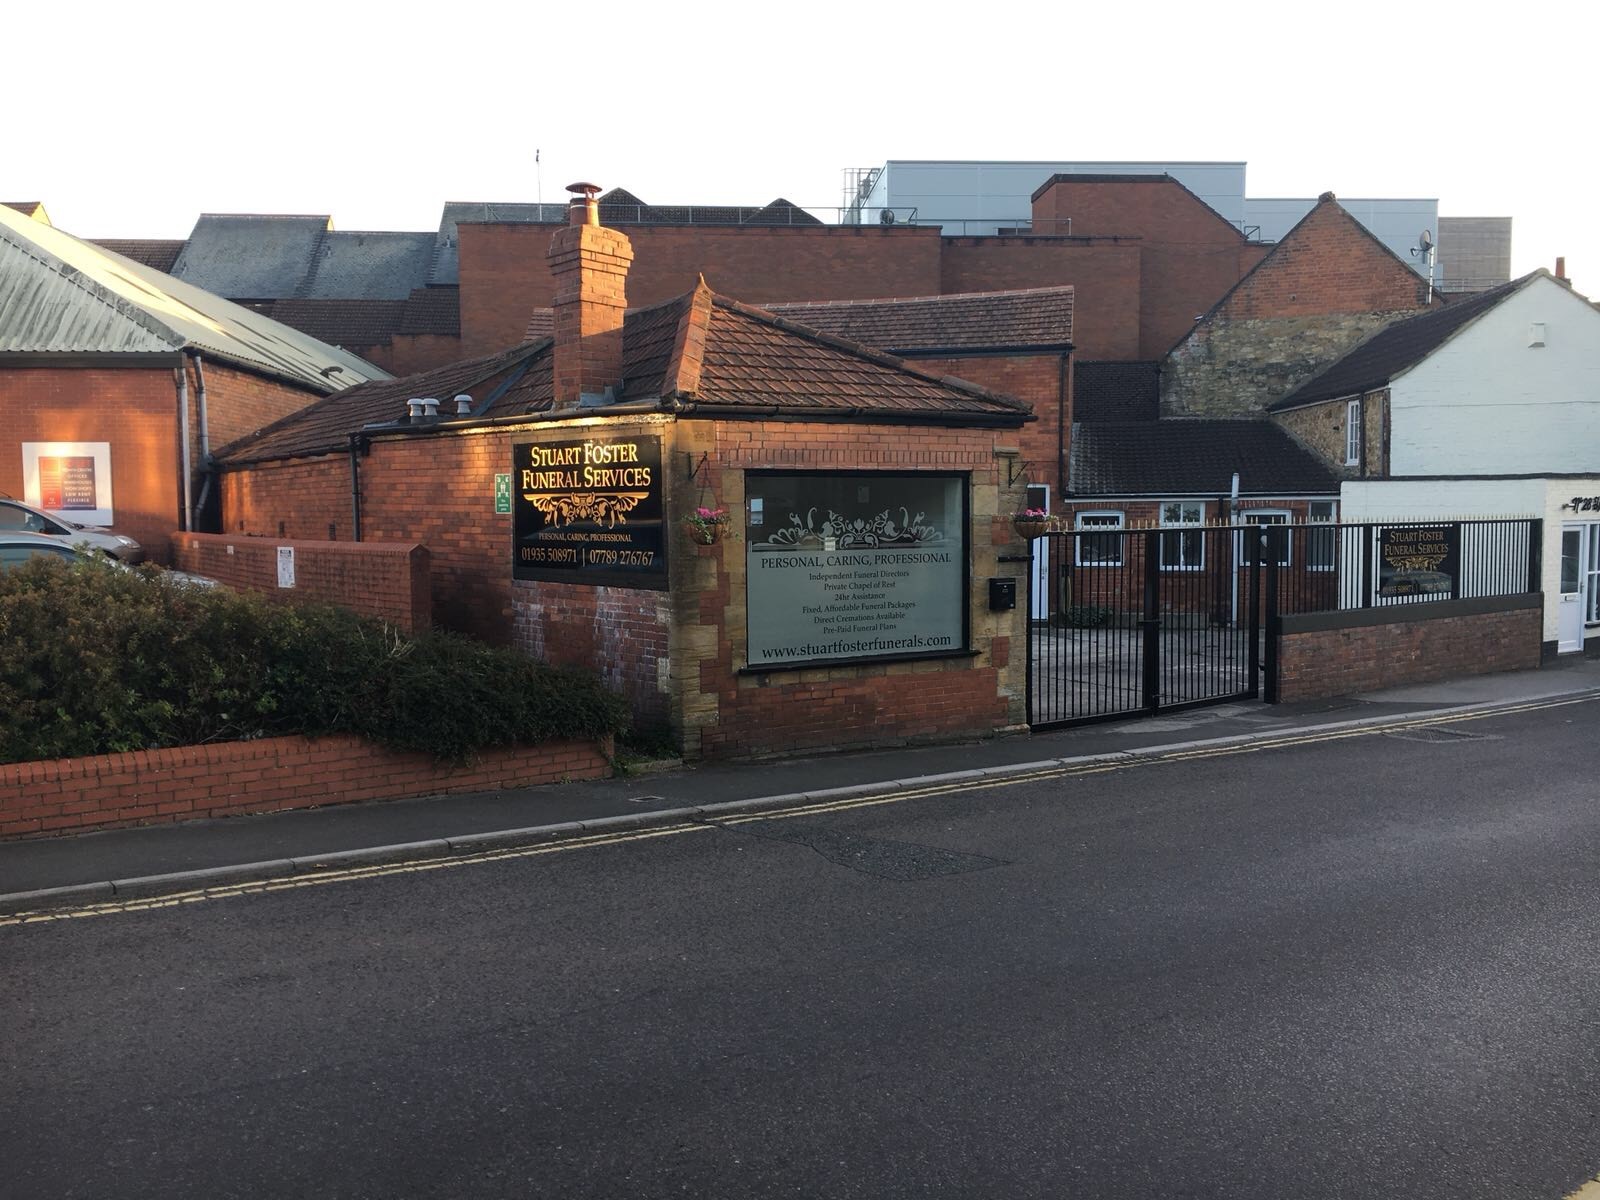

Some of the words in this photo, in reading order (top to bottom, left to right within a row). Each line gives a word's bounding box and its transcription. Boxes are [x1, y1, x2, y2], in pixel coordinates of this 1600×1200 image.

[531, 446, 581, 467] STUART
[584, 443, 638, 464] FOSTER
[522, 469, 581, 489] FUNERAL
[584, 466, 651, 488] SERVICES
[539, 533, 566, 541] PERSONAL,
[567, 533, 589, 542] CARING,
[590, 533, 632, 542] PROFESSIONAL
[1390, 531, 1418, 542] STUART
[1419, 530, 1444, 541] FOSTER
[1384, 543, 1417, 555] FUNERAL
[1418, 542, 1449, 554] SERVICES
[521, 547, 545, 561] 01935
[548, 547, 577, 563] 508971
[590, 549, 617, 564] 07789
[620, 550, 654, 566] 276767
[761, 556, 824, 568] PERSONAL,
[826, 555, 872, 567] CARING,
[875, 553, 952, 565] PROFESSIONAL
[809, 572, 852, 581] Independent
[854, 571, 879, 579] Funeral
[880, 570, 910, 578] Directors
[824, 583, 847, 591] Private
[848, 581, 872, 591] Chapel
[873, 581, 880, 589] of
[881, 580, 896, 588] Rest
[834, 593, 850, 601] 24hr
[802, 606, 823, 614] Fixed,
[824, 603, 860, 612] Affordable
[861, 602, 886, 610] Funeral
[887, 600, 916, 609] Packages
[814, 616, 835, 624] Direct
[836, 613, 874, 623] Cremations
[876, 612, 905, 620] Available
[823, 625, 851, 634] Pre-Paid
[853, 624, 878, 632] Funeral
[879, 623, 897, 631] Plans
[762, 634, 951, 659] www.stuartfosterfunerals.com
